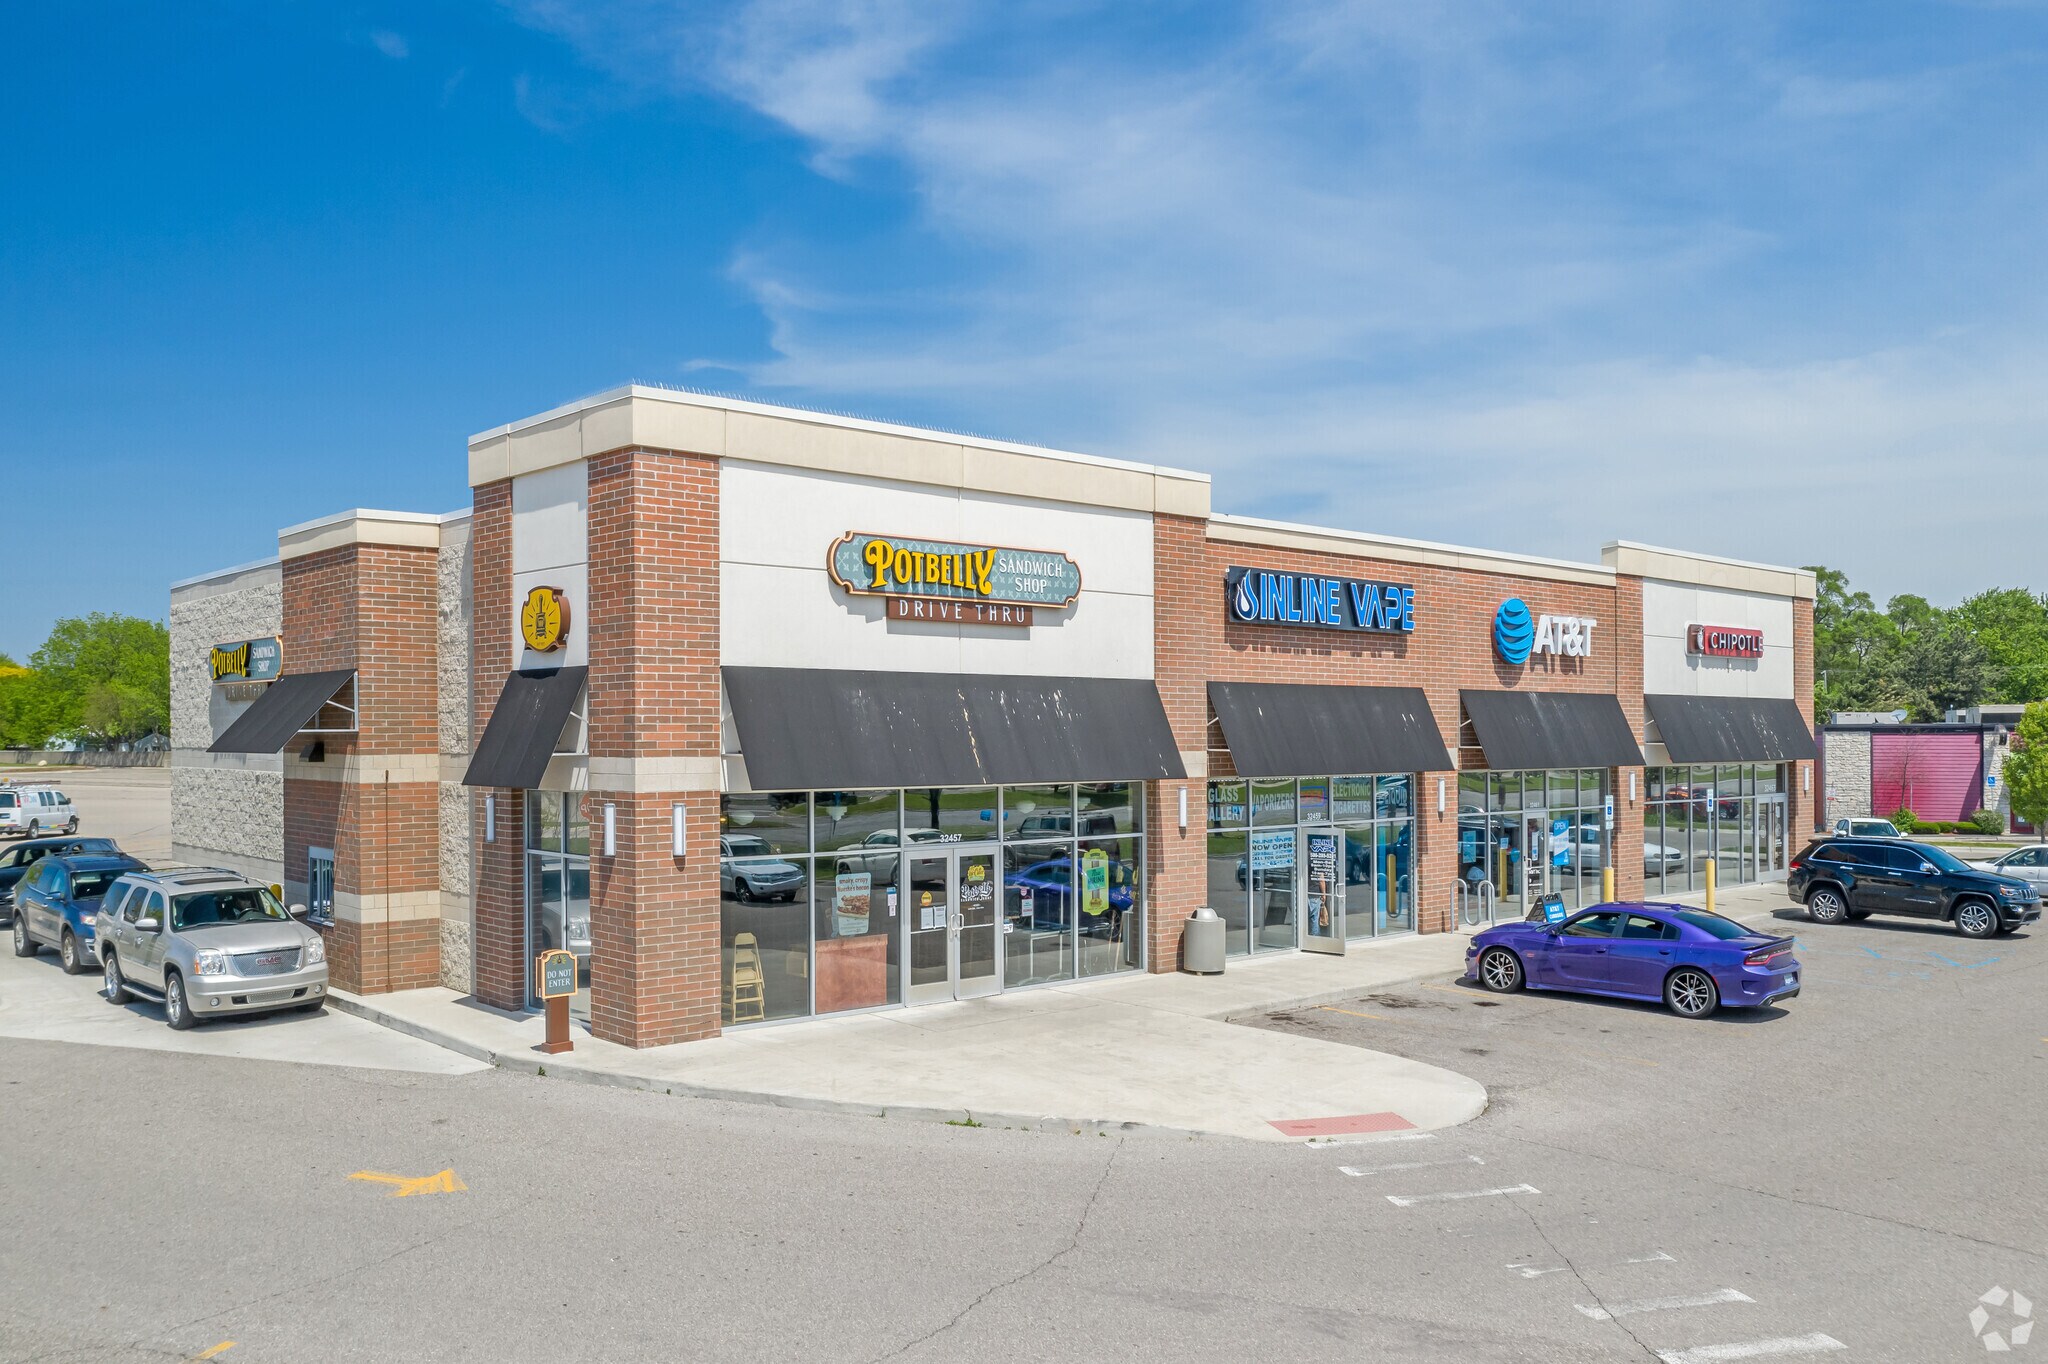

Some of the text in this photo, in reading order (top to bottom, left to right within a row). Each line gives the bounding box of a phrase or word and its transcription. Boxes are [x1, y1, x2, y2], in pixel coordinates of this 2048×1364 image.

[864, 539, 997, 596] POTBELLY
[999, 558, 1062, 578] SANDWICH
[1015, 577, 1047, 594] SHOP
[1260, 573, 1416, 631] INLINE VAPE
[899, 600, 1025, 623] DRIVE THRU
[1533, 614, 1597, 657] AT&T
[1710, 631, 1764, 652] CHIPOTLE
[211, 642, 247, 679] POTBELLY
[252, 646, 275, 659] SANDWICH
[257, 660, 270, 672] SHOP
[1208, 787, 1238, 803] GLASS
[1208, 805, 1245, 822] ALLERY
[1554, 822, 1566, 830] OPEN
[940, 834, 962, 843] 32457
[1272, 842, 1293, 850] OPEN
[547, 969, 572, 979] DO NOT
[548, 978, 571, 988] ENTER
